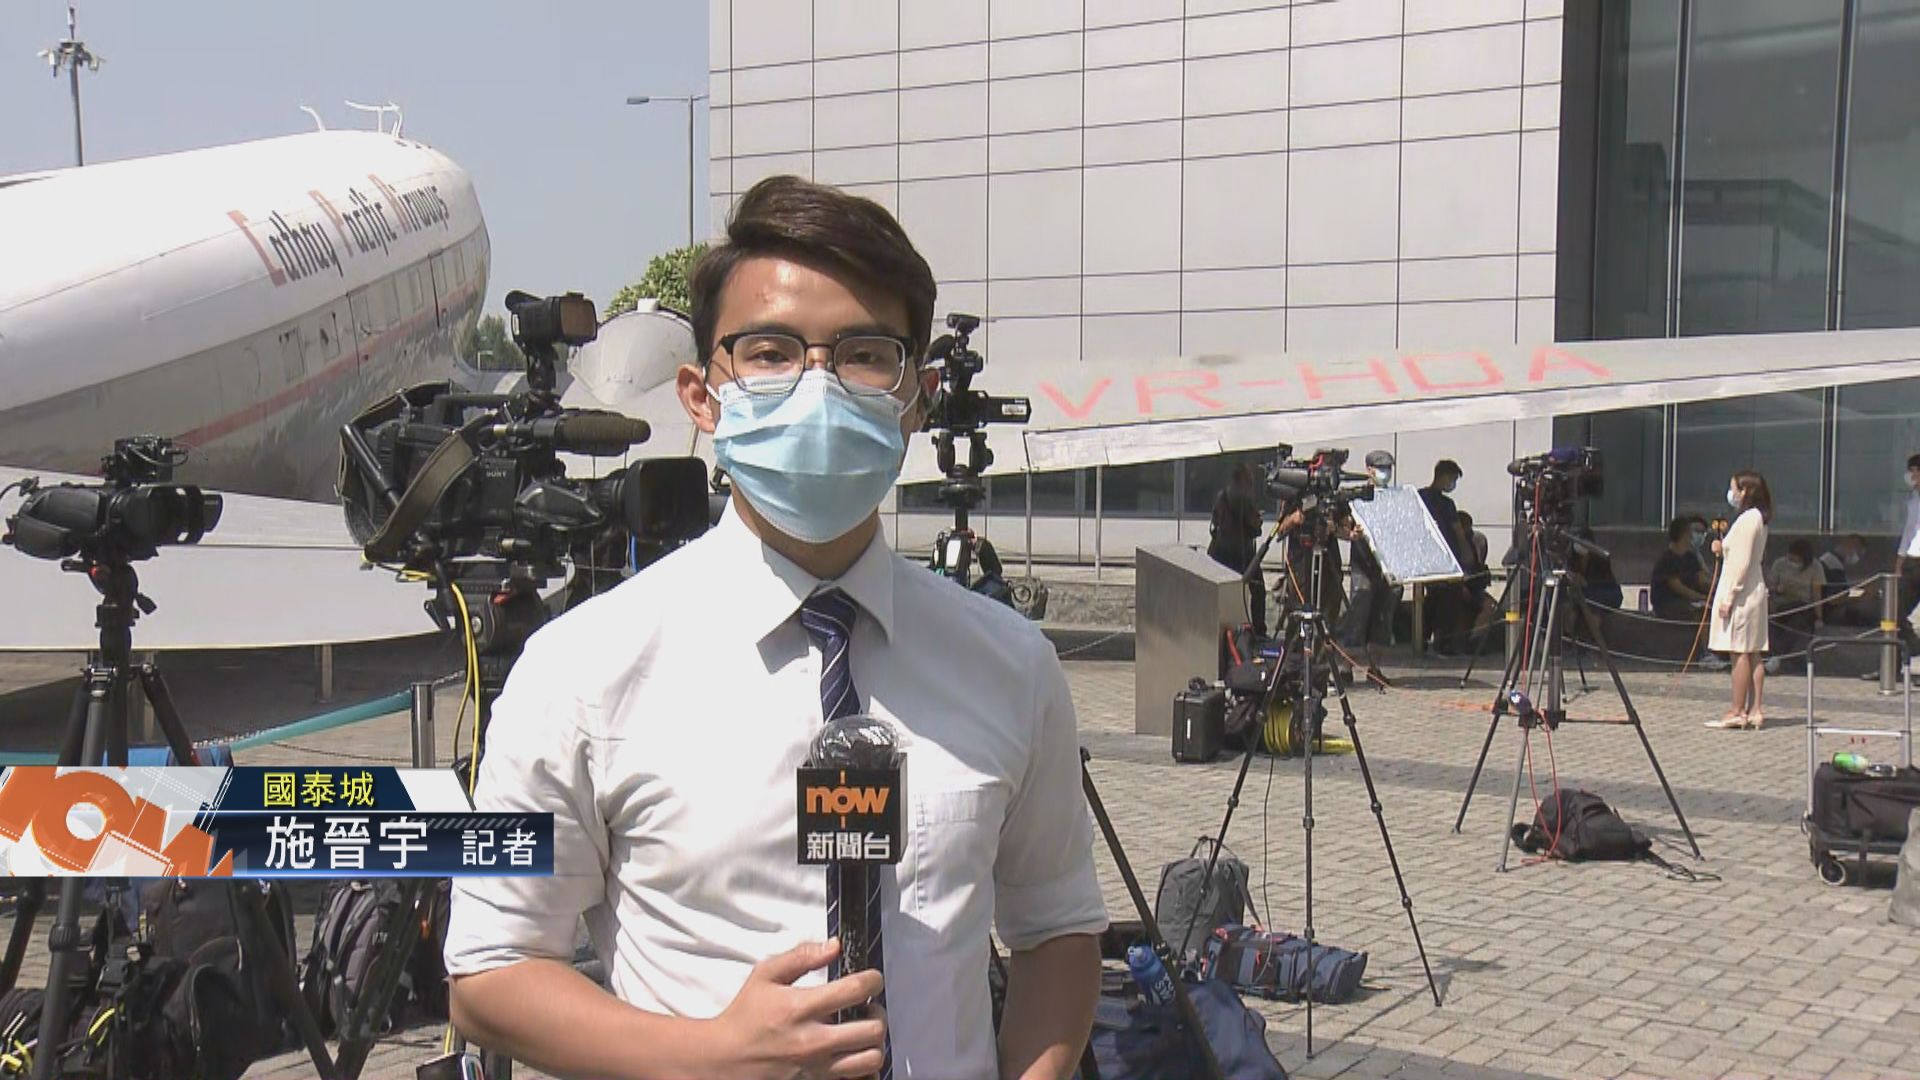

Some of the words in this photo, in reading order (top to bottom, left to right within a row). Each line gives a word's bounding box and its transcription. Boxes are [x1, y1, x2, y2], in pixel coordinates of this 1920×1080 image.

[226, 210, 343, 287] Cathay
[308, 187, 398, 257] Pacific
[368, 174, 450, 233] Airways
[806, 785, 891, 815] now
[806, 831, 891, 860] 新聞台
